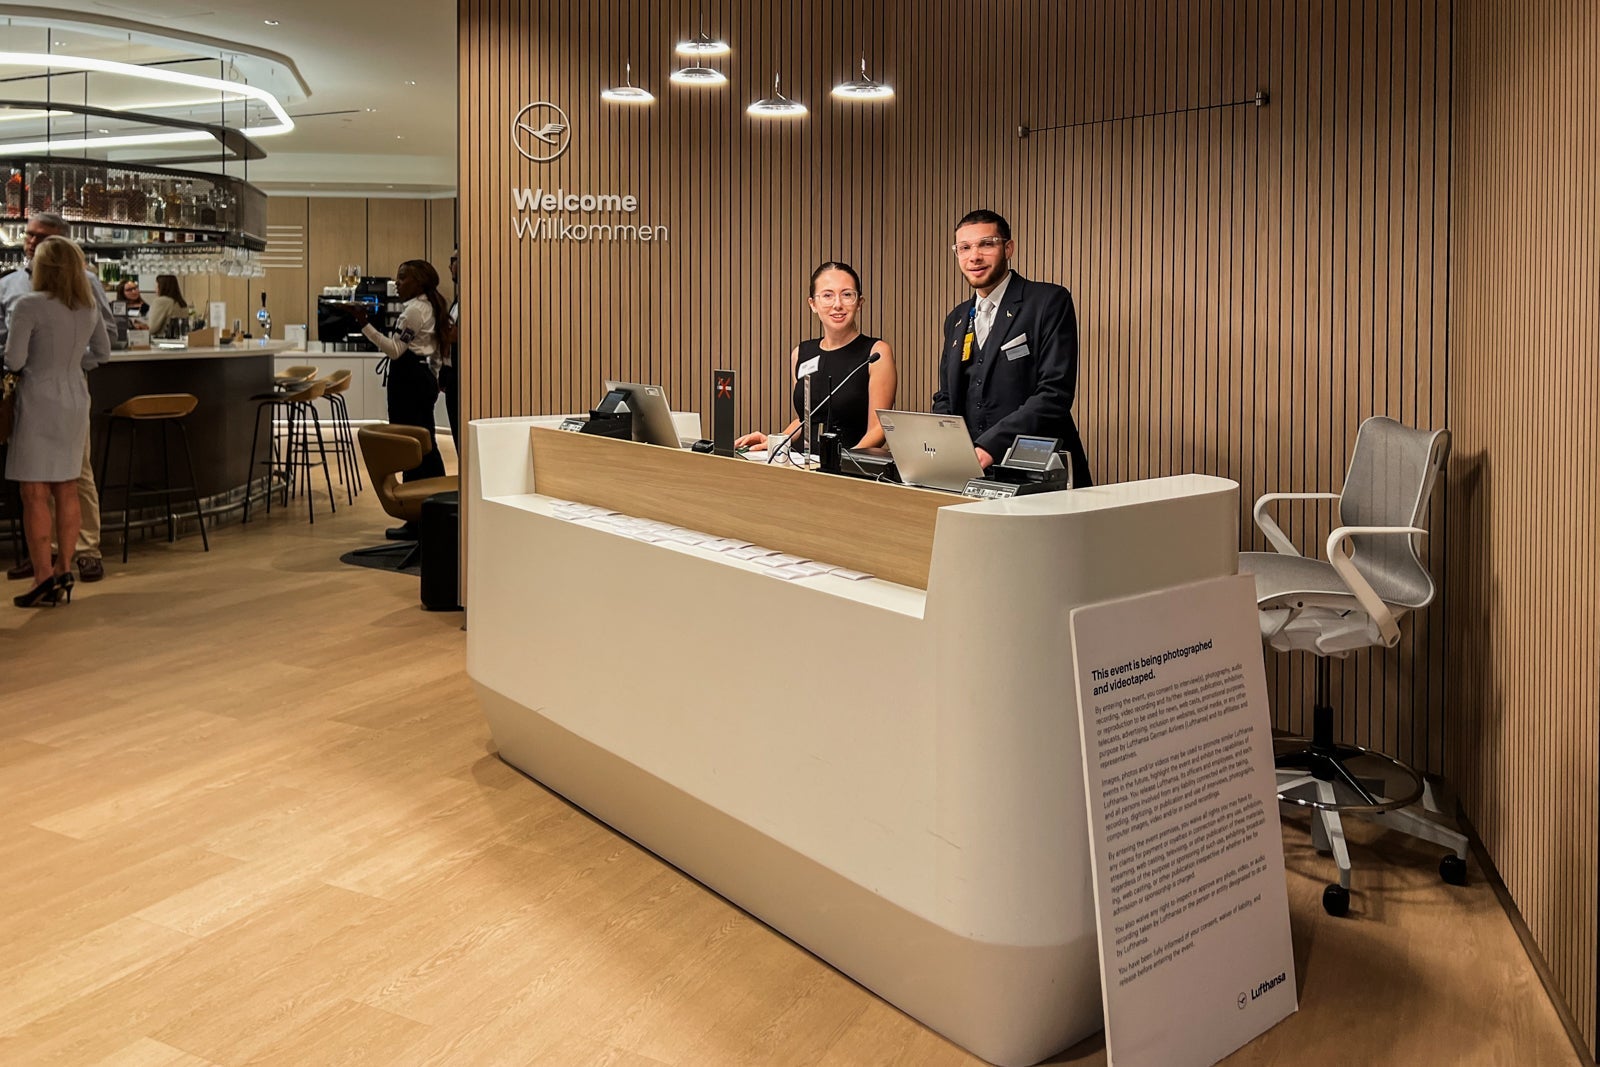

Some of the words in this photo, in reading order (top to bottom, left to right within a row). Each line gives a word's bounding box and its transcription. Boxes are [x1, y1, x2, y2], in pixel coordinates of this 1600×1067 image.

[513, 188, 637, 211] Welcome
[513, 217, 668, 240] Willkommen
[1092, 668, 1109, 681] This
[1111, 662, 1132, 676] event
[1133, 659, 1140, 670] is
[1141, 655, 1161, 667] being
[1163, 638, 1212, 663] photographed
[1093, 682, 1109, 695] and
[1110, 669, 1155, 691] videotaped.
[1102, 700, 1122, 711] entering
[1121, 707, 1133, 716] video
[1103, 719, 1133, 733] reproduction
[1098, 746, 1118, 759] purpose
[1126, 735, 1148, 747] Lufthansa
[1121, 769, 1137, 781] photos
[1102, 786, 1118, 797] events
[1104, 809, 1114, 819] and
[1121, 801, 1140, 815] persons
[1159, 794, 1183, 810] publication
[1106, 828, 1129, 842] computer
[1115, 843, 1135, 856] entering
[1145, 832, 1157, 843] event
[1118, 856, 1134, 867] claims
[1136, 860, 1146, 870] web
[1111, 877, 1135, 893] regardless
[1122, 889, 1132, 900] web
[1113, 899, 1137, 915] admission
[1115, 930, 1138, 945] recording
[1139, 923, 1152, 933] taken
[1159, 908, 1181, 923] Lufthansa
[1124, 919, 1135, 929] also
[1136, 913, 1148, 923] waive
[1128, 959, 1139, 969] have
[1140, 952, 1152, 963] been
[1119, 973, 1136, 986] release
[1137, 964, 1152, 976] before
[1251, 973, 1286, 1000] Lufthansa
